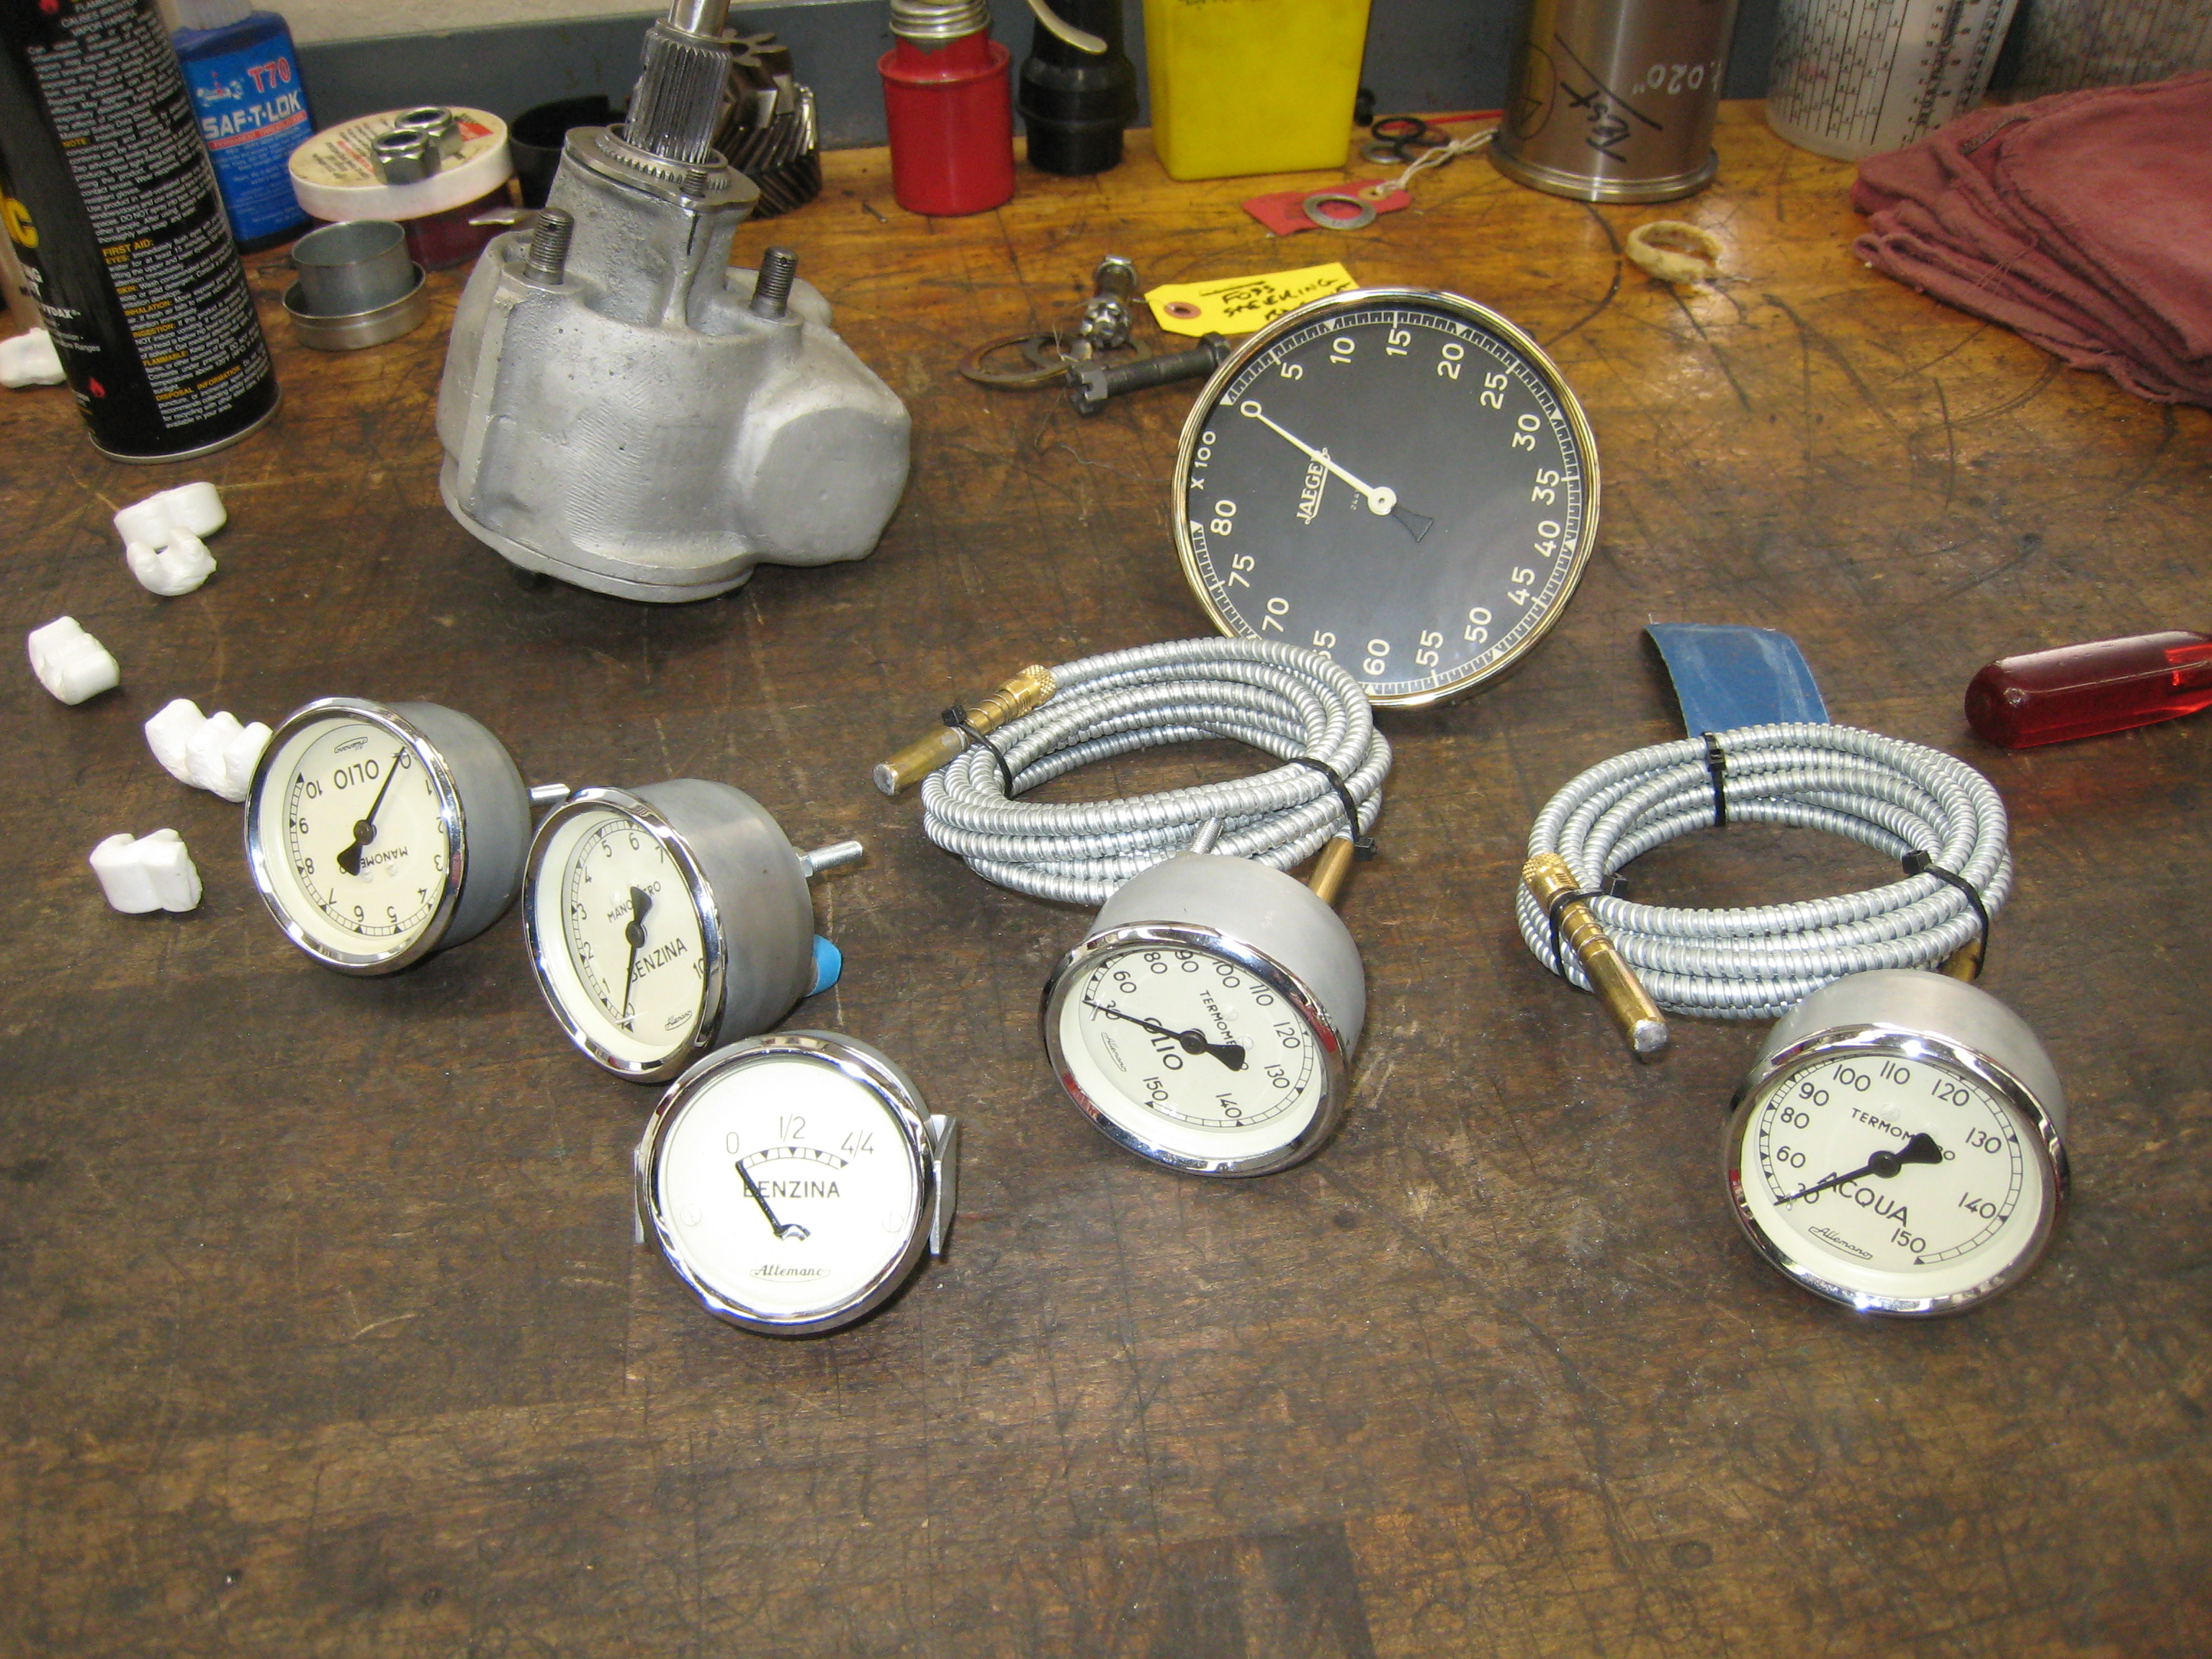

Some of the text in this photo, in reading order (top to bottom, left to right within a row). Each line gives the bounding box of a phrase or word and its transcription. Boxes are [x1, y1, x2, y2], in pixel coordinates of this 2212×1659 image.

[248, 58, 290, 93] T70
[132, 210, 149, 218] NOT
[102, 245, 130, 256] FIRST
[116, 284, 138, 294] SKIN:
[125, 300, 172, 316] INHALATION:
[132, 323, 175, 338] INGESTION:
[136, 337, 150, 346] NOT
[1386, 329, 1411, 356] 15
[143, 350, 188, 366] FLAMMABLE:
[1330, 337, 1355, 364] 10
[1437, 343, 1465, 379] 20
[1280, 364, 1303, 381] 5
[156, 386, 192, 401] DISPOSAL
[1480, 372, 1508, 410] 25
[1240, 400, 1262, 418] 0
[1512, 413, 1540, 451] 30
[1194, 431, 1216, 468] 100
[1296, 448, 1331, 525] JAEGE
[1532, 468, 1560, 505] 35
[1210, 500, 1237, 536] 80
[1534, 521, 1560, 559] 40
[1228, 554, 1254, 588] 75
[1507, 566, 1535, 606] 45
[1262, 598, 1290, 632] 70
[1465, 607, 1492, 644] 50
[1363, 639, 1390, 675] 60
[1416, 630, 1444, 667] 55
[333, 759, 379, 790] OLIO
[306, 780, 323, 799] 10
[299, 817, 309, 834] 9
[602, 840, 612, 858] 5
[629, 832, 640, 850] 6
[305, 858, 315, 874] 8
[434, 855, 443, 871] 3
[655, 846, 666, 863] 7
[585, 866, 593, 883] 4
[328, 888, 337, 904] 7
[418, 888, 428, 904] 4
[607, 881, 662, 924] MANOTRO
[387, 906, 397, 922] 5
[577, 903, 587, 920] 3
[584, 942, 594, 960] 2
[626, 938, 688, 983] BENZINA
[1143, 952, 1167, 974] 80
[1175, 950, 1199, 972] 90
[1113, 971, 1137, 994] 60
[1213, 961, 1241, 988] 100
[603, 978, 613, 996] 1
[1249, 985, 1274, 1007] 110
[1200, 989, 1249, 1071] TERMOMEO
[1273, 1022, 1300, 1048] 120
[1143, 1017, 1183, 1070] OLIO
[1264, 1064, 1290, 1089] 130
[1833, 1064, 1871, 1092] 100
[1880, 1061, 1910, 1084] 110
[1143, 1077, 1169, 1101] 150
[1798, 1082, 1829, 1106] 90
[1931, 1079, 1969, 1107] 120
[1215, 1093, 1242, 1118] 140
[1780, 1107, 1809, 1128] 80
[779, 1113, 806, 1142] 1/2
[726, 1131, 739, 1154] 0
[842, 1129, 874, 1158] 4/4
[1965, 1127, 2002, 1154] 130
[1776, 1146, 1806, 1168] 60
[743, 1181, 840, 1198] BENZINA
[1818, 1172, 1910, 1227] ACQUA
[1958, 1192, 1996, 1219] 140
[1890, 1228, 1926, 1254] 150
